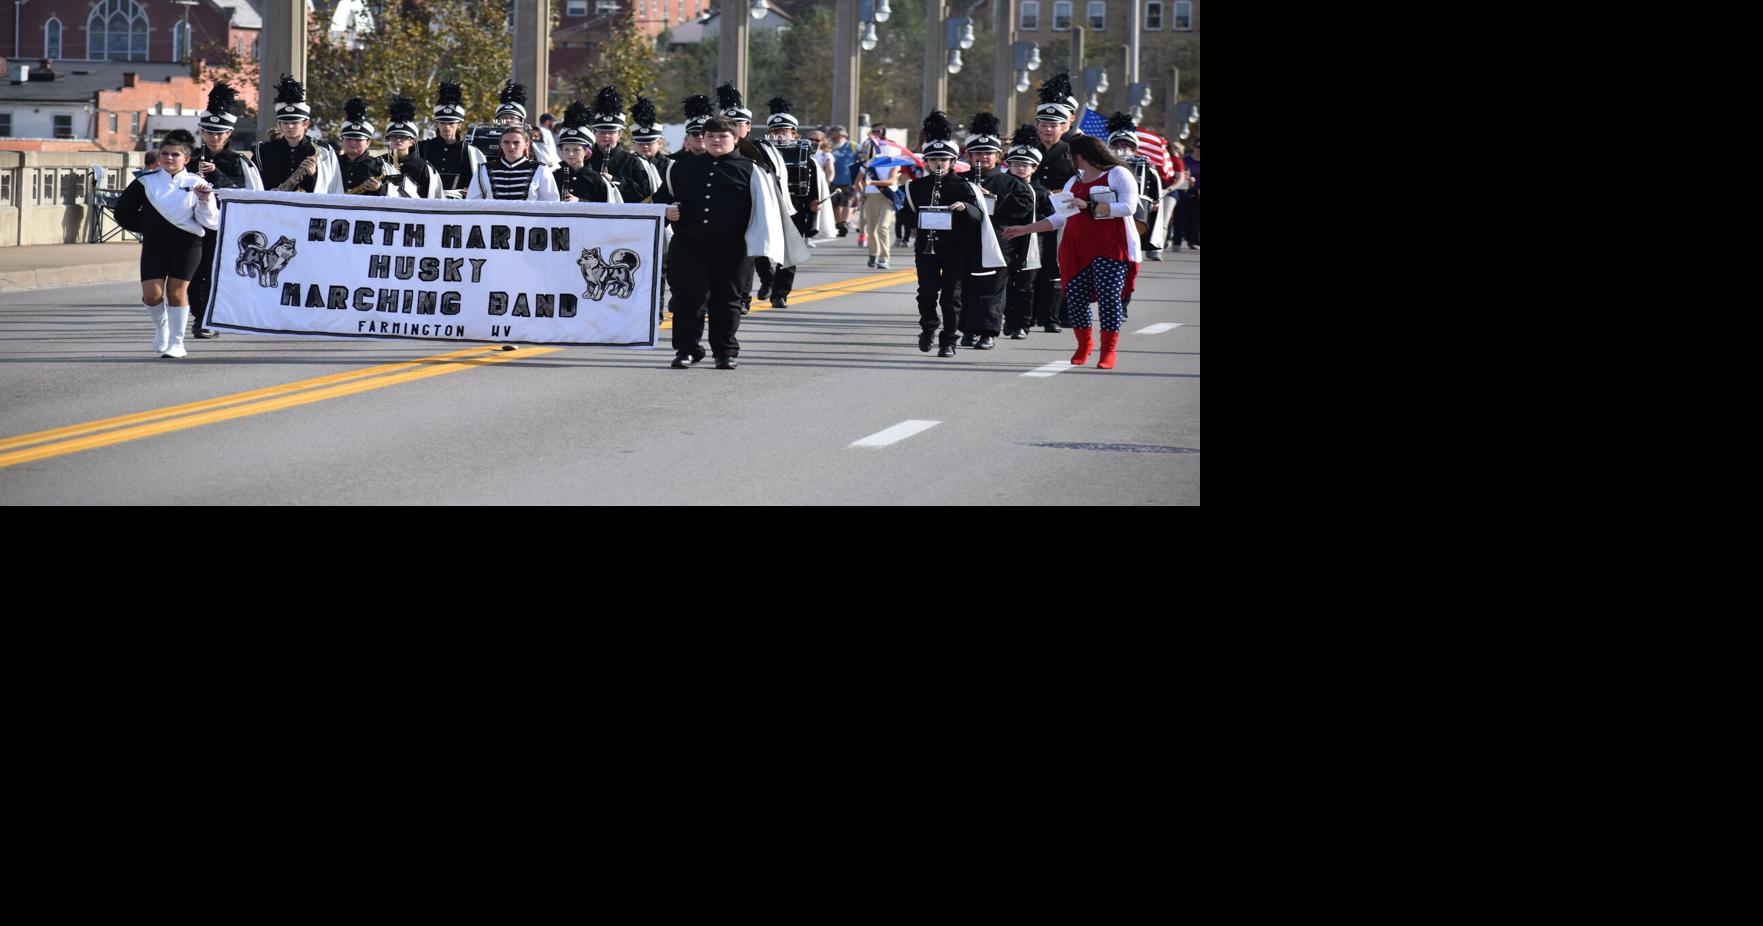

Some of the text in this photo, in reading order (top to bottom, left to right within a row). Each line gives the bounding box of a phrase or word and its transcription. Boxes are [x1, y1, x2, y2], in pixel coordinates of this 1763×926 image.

[308, 217, 571, 252] NORTH MARION
[368, 254, 487, 283] HUSKY
[280, 282, 578, 318] MARCHING BAND
[358, 320, 512, 337] FARMINGTON WV
